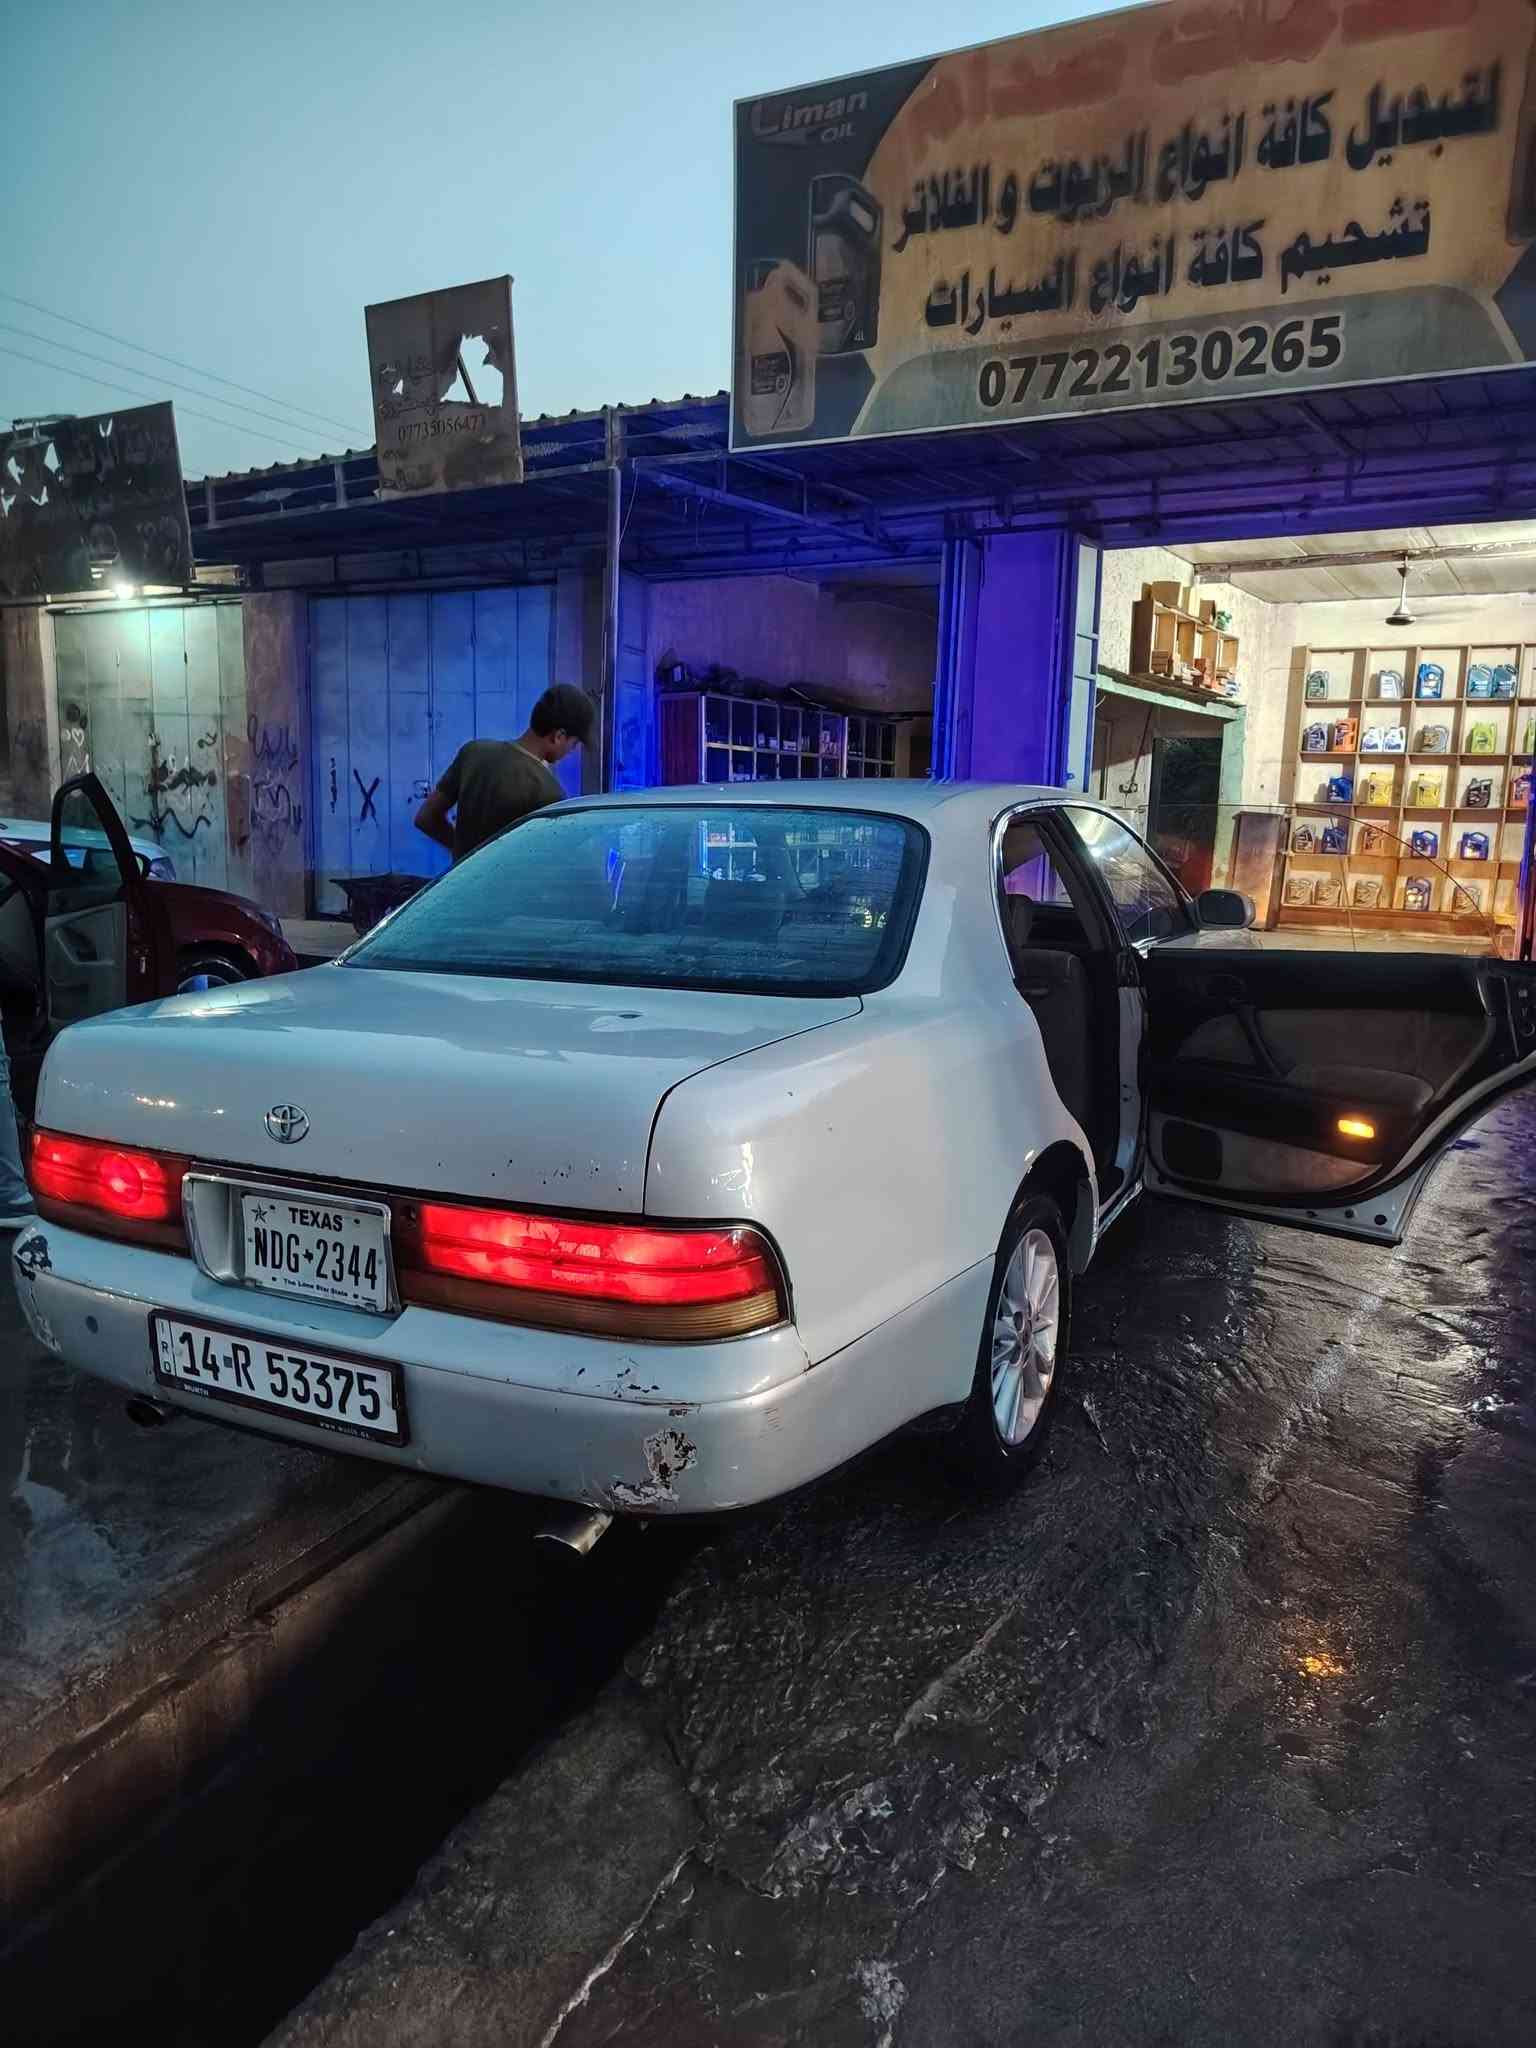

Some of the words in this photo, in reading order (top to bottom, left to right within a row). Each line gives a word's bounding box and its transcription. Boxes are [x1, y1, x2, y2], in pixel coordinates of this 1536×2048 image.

[752, 91, 867, 135] Liman
[1154, 106, 1247, 202] انواع
[1257, 88, 1335, 169] كافة
[1029, 128, 1148, 222] الزيوت
[1089, 230, 1176, 315] انواع
[1188, 217, 1266, 288] كافة
[1281, 197, 1431, 294] تشحيم
[925, 248, 1077, 336] السيارات
[979, 314, 1342, 408] 07722130265
[288, 1207, 343, 1232] TEXAS
[266, 1351, 380, 1421] 53375
